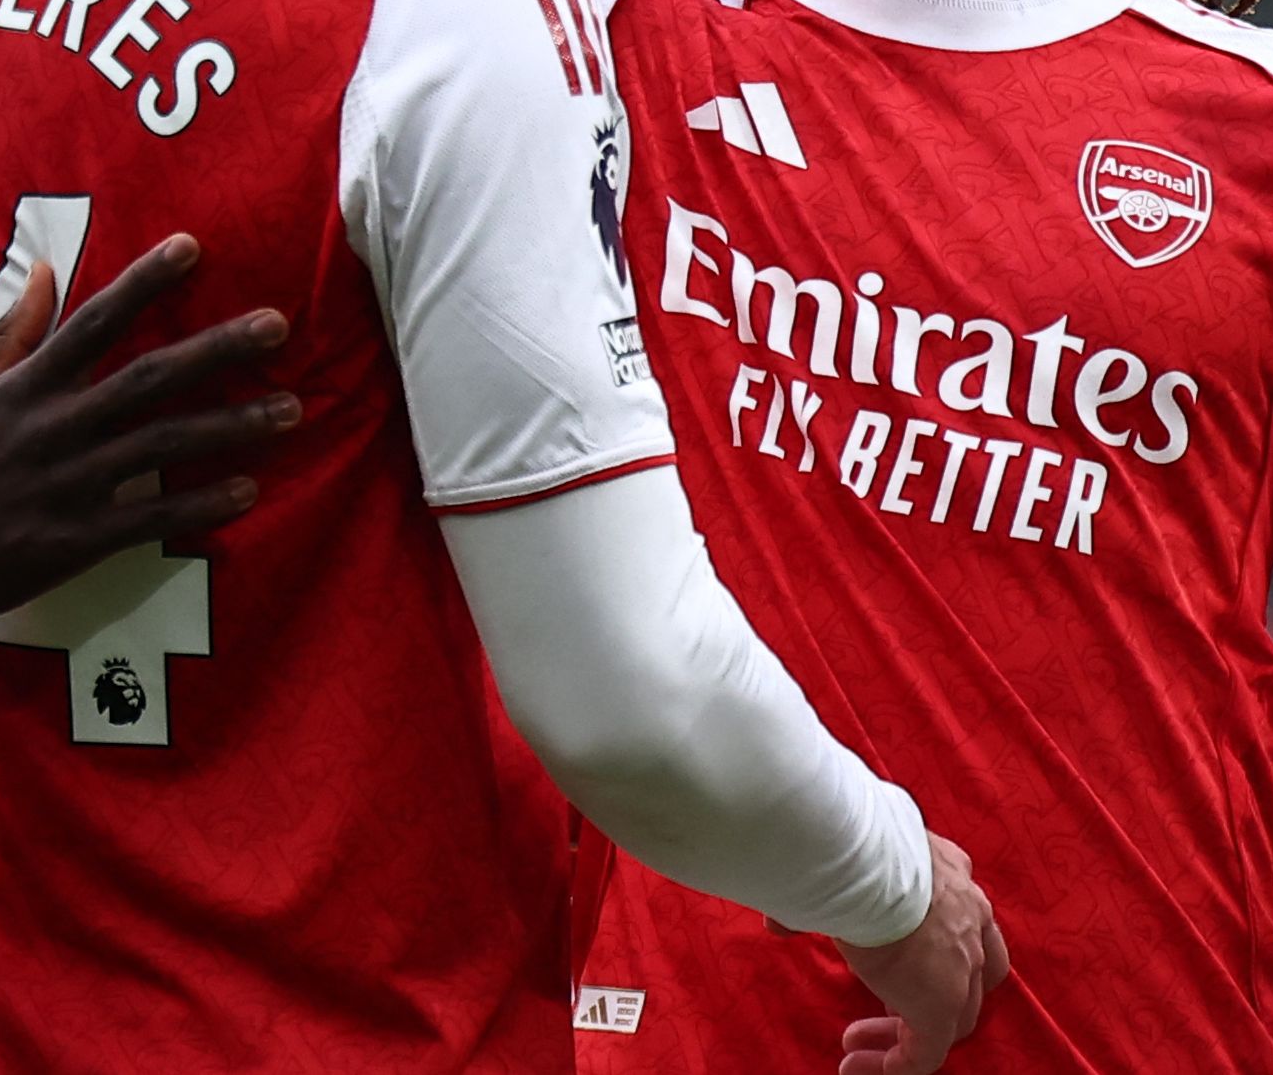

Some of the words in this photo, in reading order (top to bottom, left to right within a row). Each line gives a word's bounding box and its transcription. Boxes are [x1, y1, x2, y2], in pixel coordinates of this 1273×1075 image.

[1099, 156, 1194, 196] Arsenal
[659, 195, 1200, 464] Emirates
[728, 362, 823, 473] FLY
[839, 408, 1109, 555] BETTER
